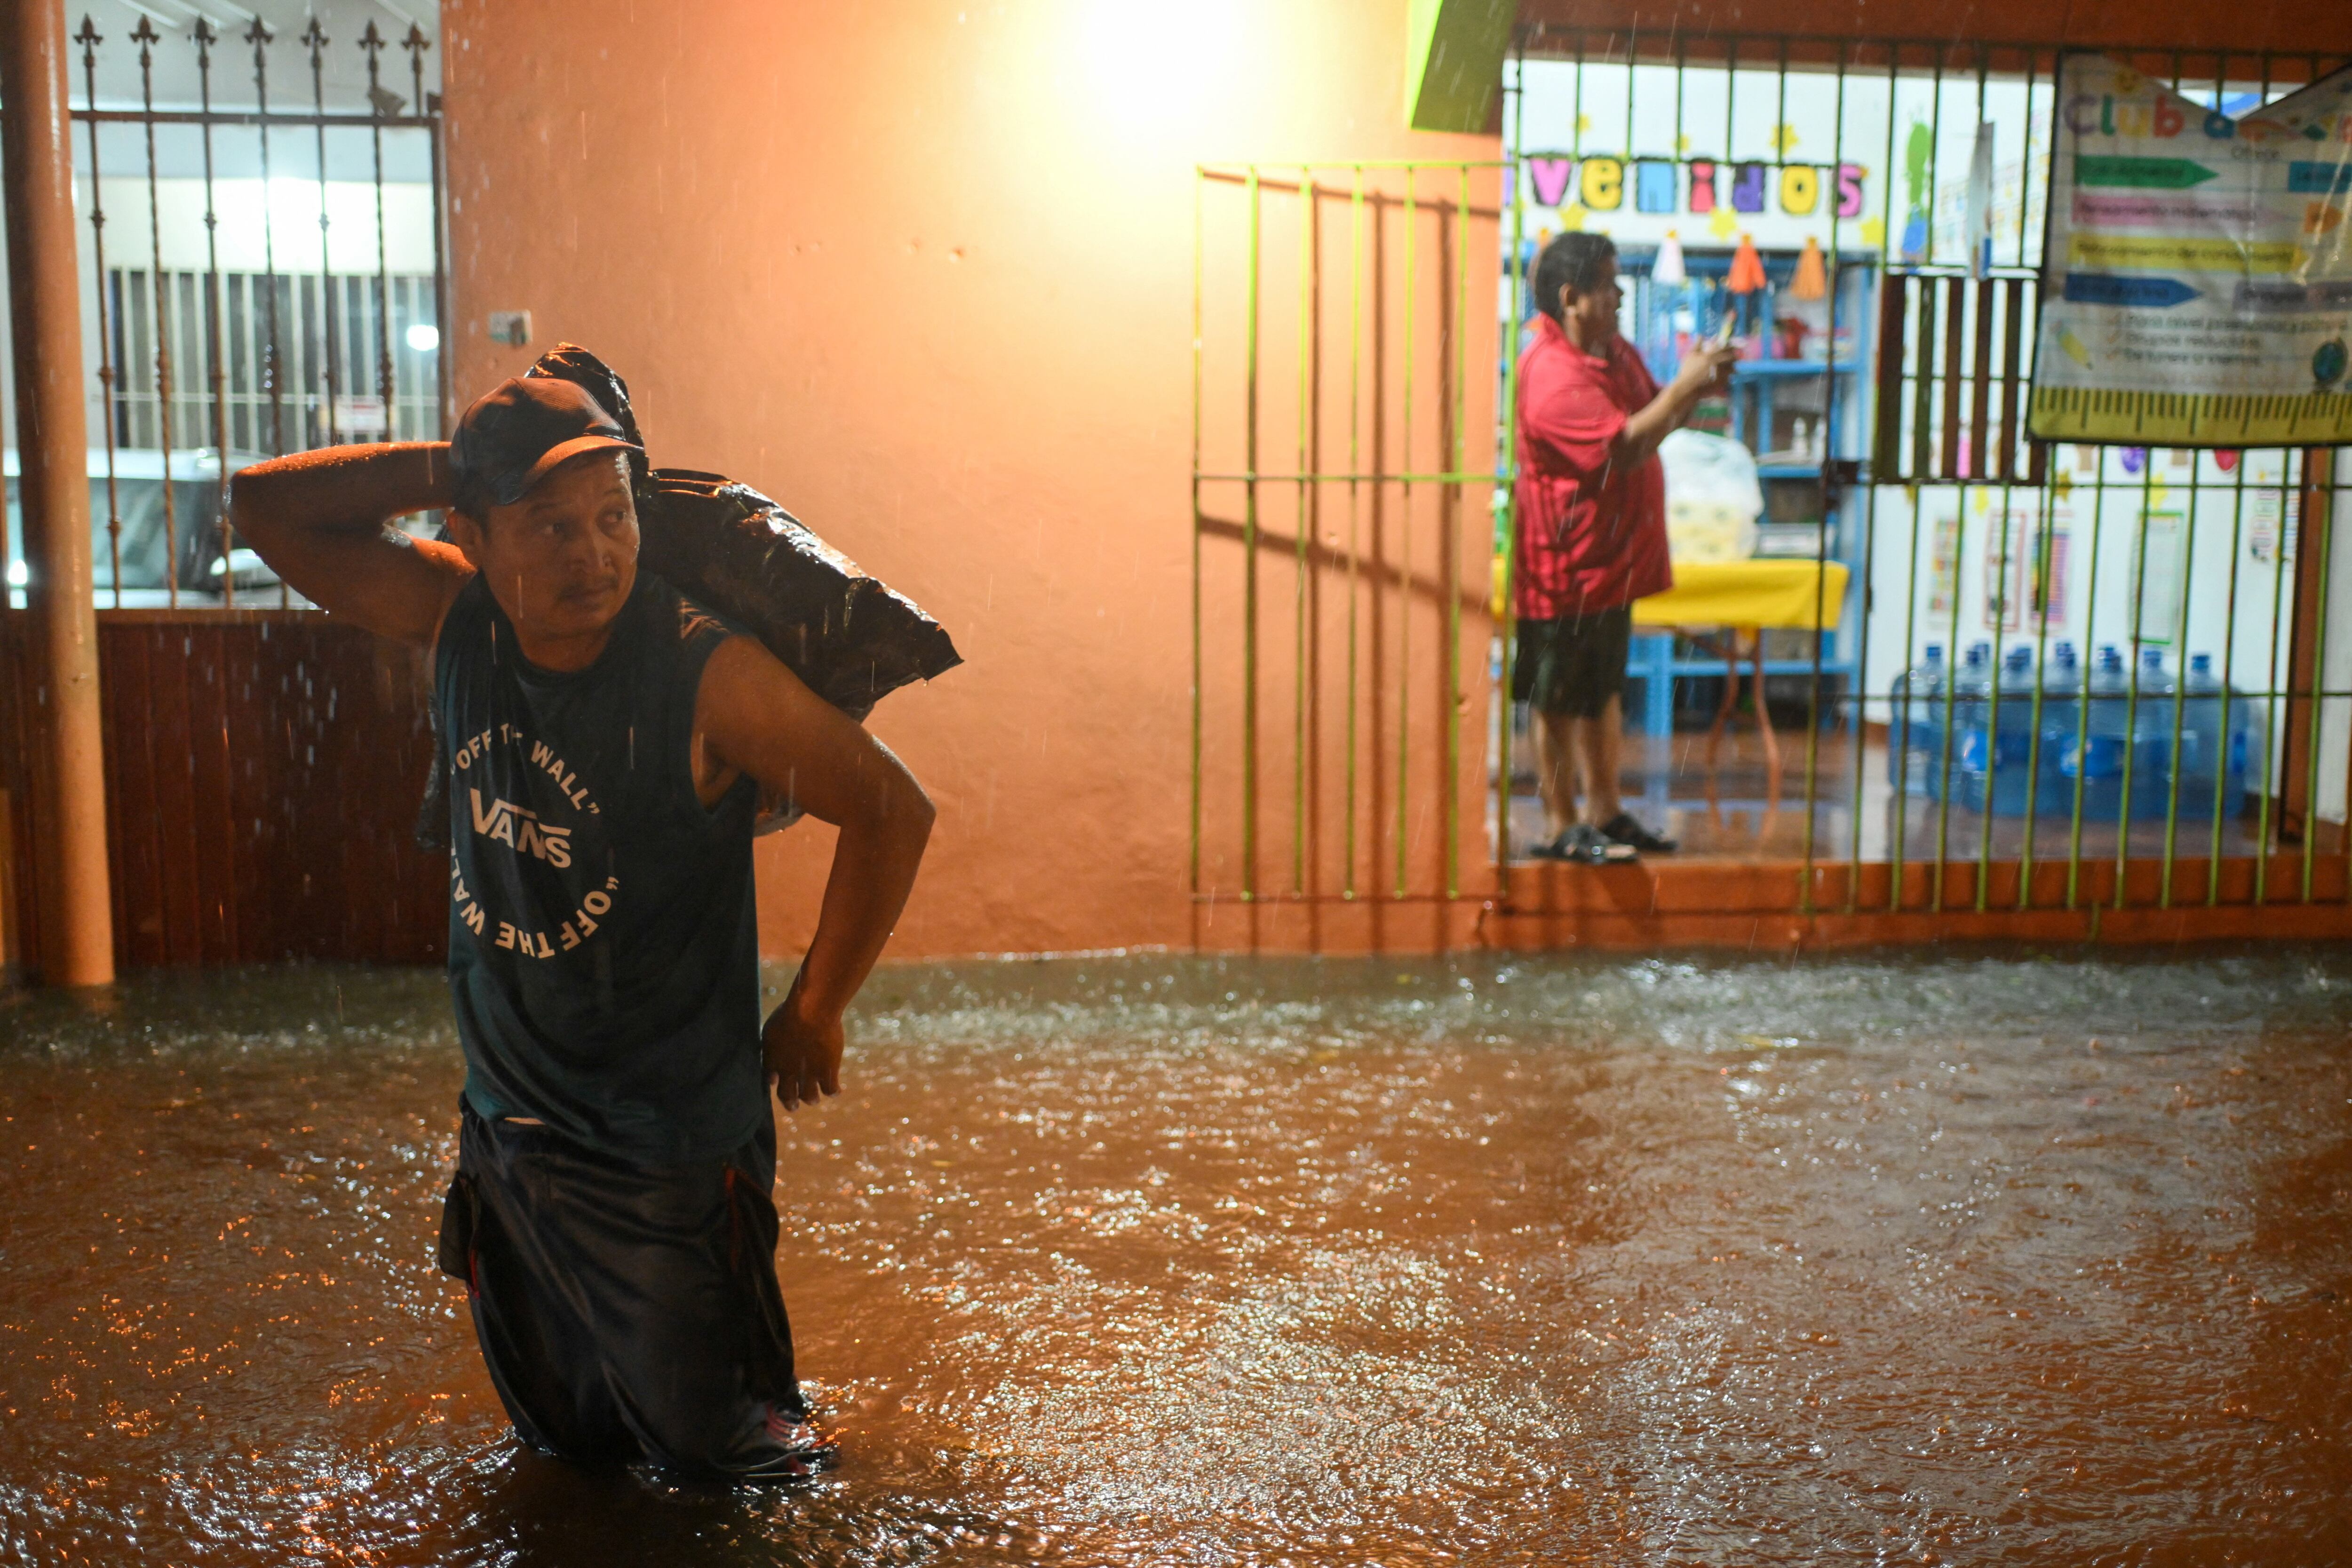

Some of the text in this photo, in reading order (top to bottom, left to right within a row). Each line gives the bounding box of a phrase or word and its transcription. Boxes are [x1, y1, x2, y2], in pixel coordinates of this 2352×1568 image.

[2064, 94, 2185, 139] Club
[1503, 152, 1863, 219] venidos
[470, 788, 572, 868] VANS
[495, 921, 556, 959] THE
